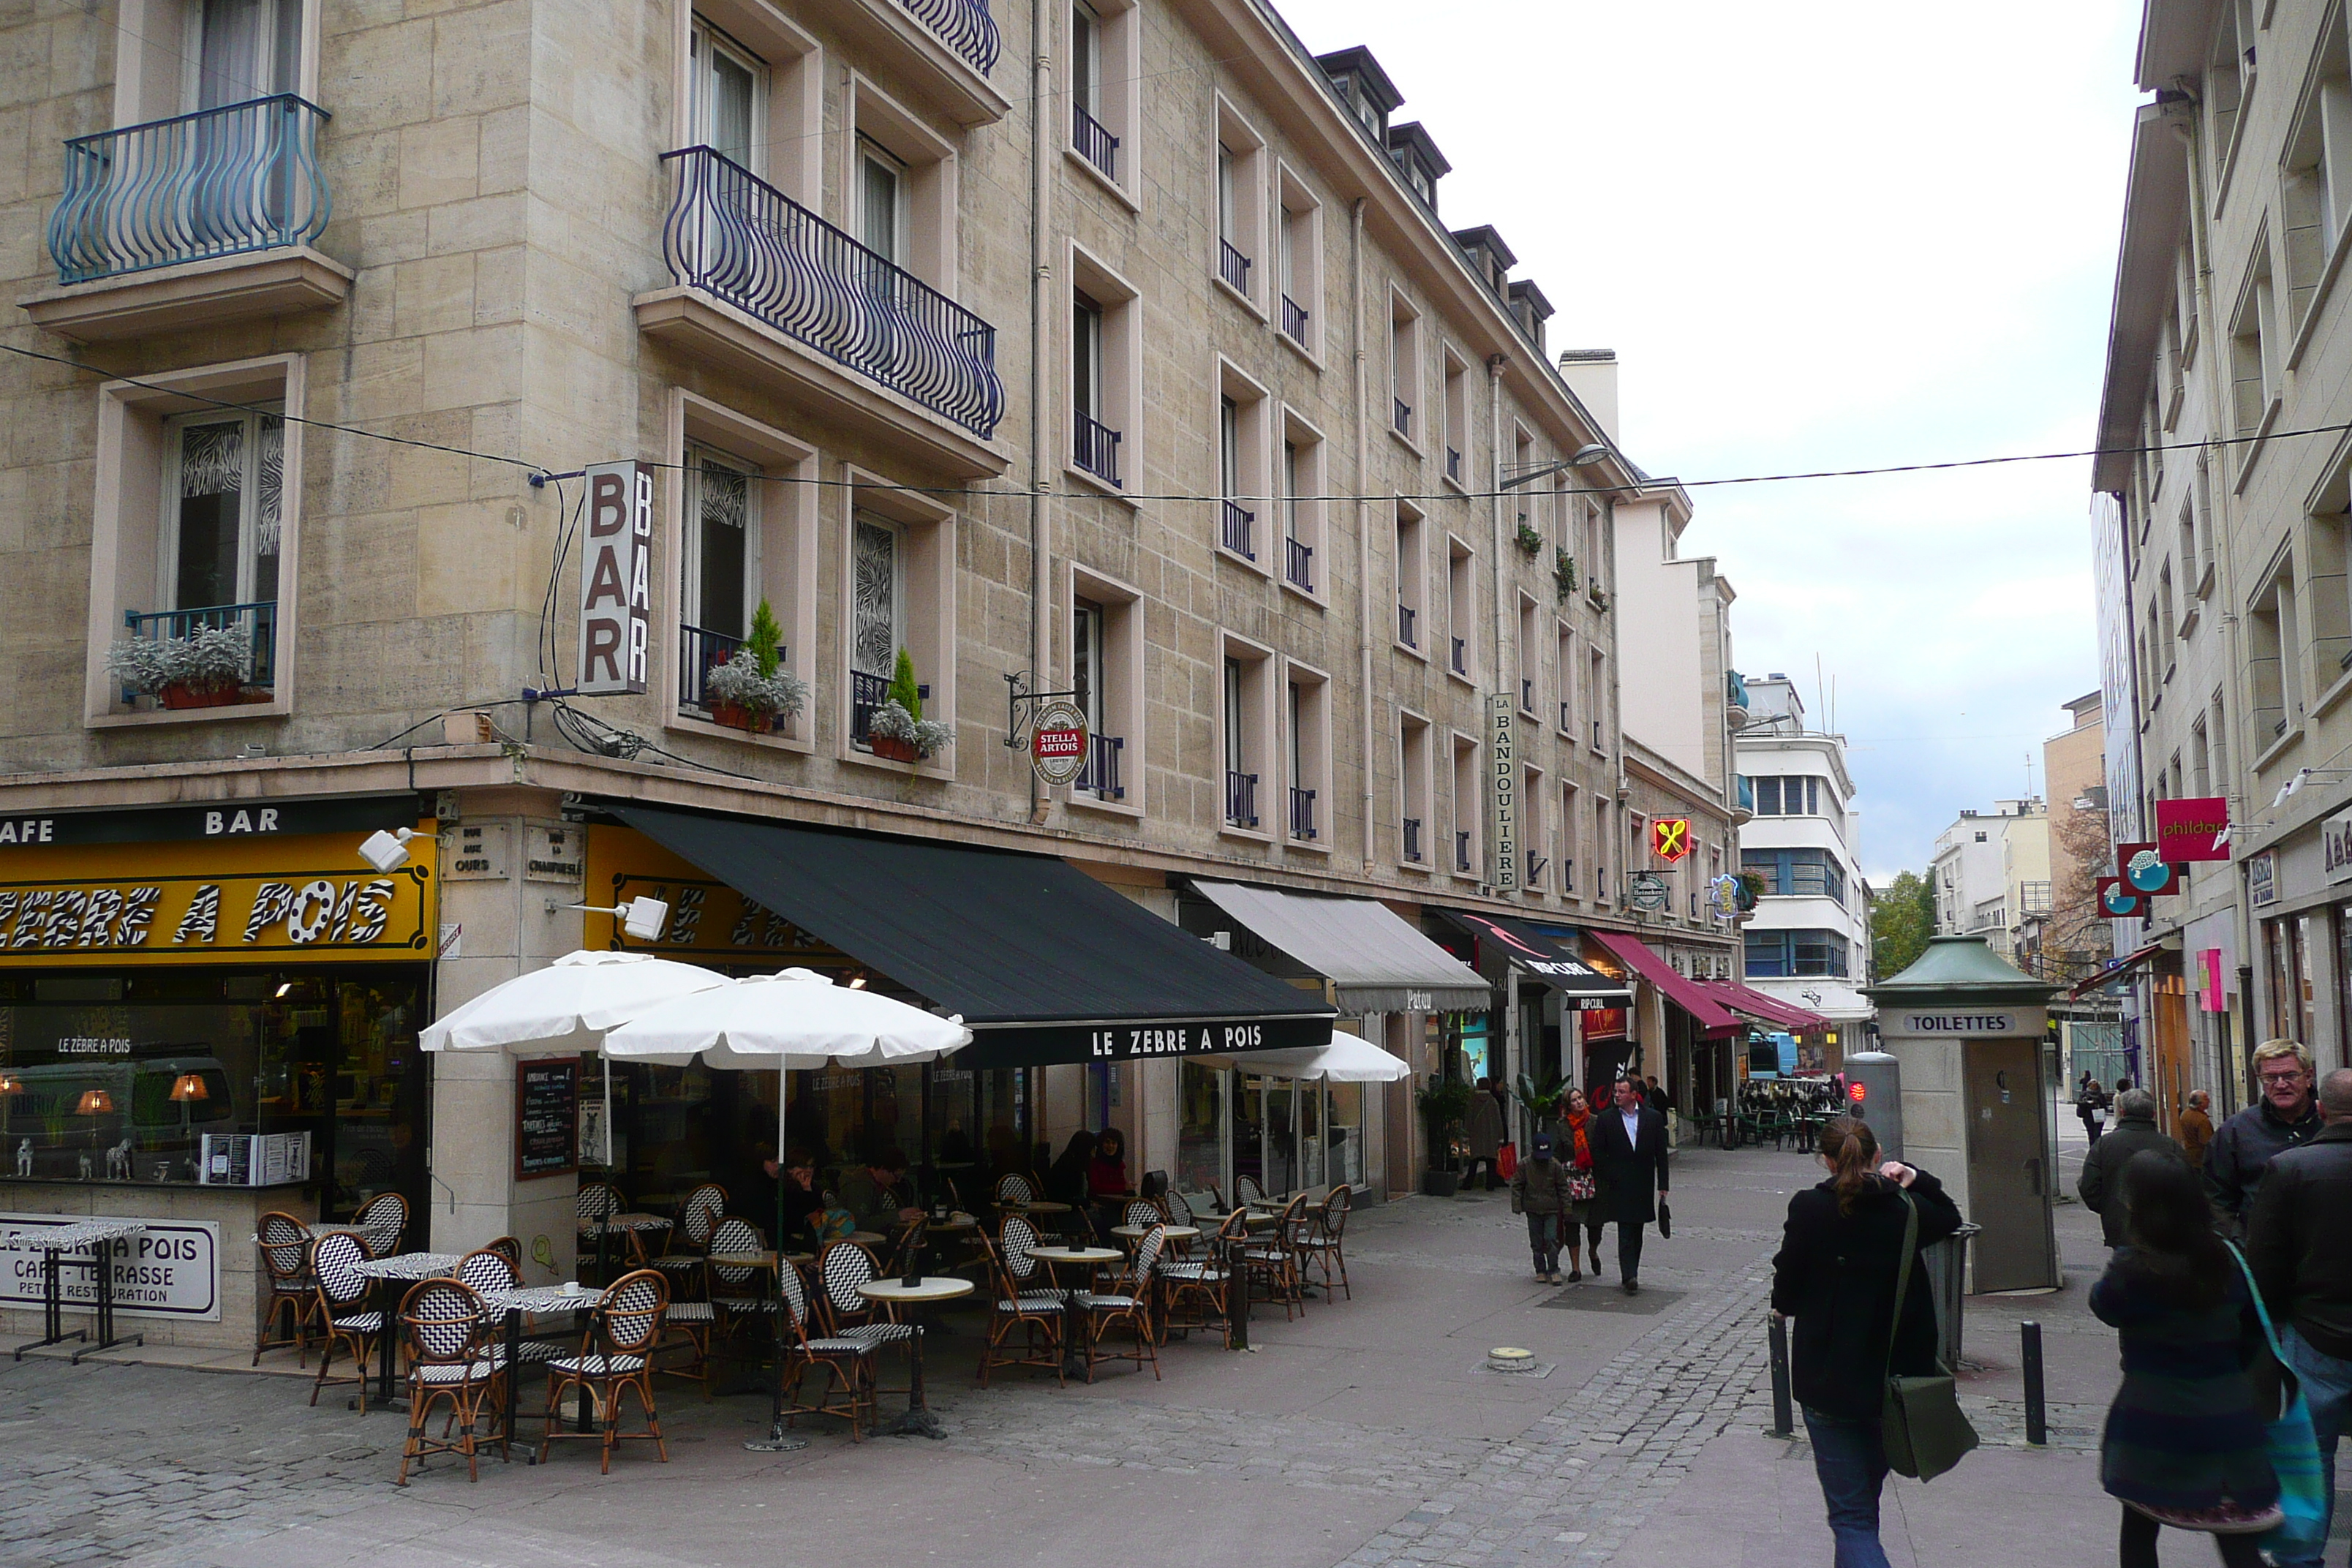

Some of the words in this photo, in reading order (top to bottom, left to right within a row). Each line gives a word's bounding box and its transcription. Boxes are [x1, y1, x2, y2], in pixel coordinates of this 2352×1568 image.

[584, 472, 627, 682] BAR
[629, 471, 652, 683] BAR
[1496, 700, 1509, 709] LA
[1040, 734, 1078, 743] STELLA
[1040, 742, 1078, 752] ARTOIS
[1496, 716, 1512, 885] BANDOULIERE
[206, 808, 279, 834] BAR
[2163, 820, 2223, 839] phildar
[455, 859, 489, 871] OURS
[1633, 889, 1664, 897] Heineken
[172, 884, 220, 943] A
[242, 879, 395, 943] POIS
[1580, 998, 1590, 1009] RIP
[1590, 998, 1605, 1009] CURL
[1913, 1016, 2006, 1030] TOILETTES
[59, 1039, 69, 1052] LE
[100, 1039, 107, 1052] A
[109, 1039, 130, 1053] POIS
[1093, 1031, 1113, 1055] LE
[1130, 1029, 1186, 1054] ZEBRE
[1200, 1028, 1213, 1049] A
[1224, 1025, 1262, 1048] POIS
[113, 1236, 129, 1258] A
[138, 1237, 197, 1261] POIS
[80, 1264, 174, 1286] TERASSE
[67, 1285, 167, 1302] RESTURATION
